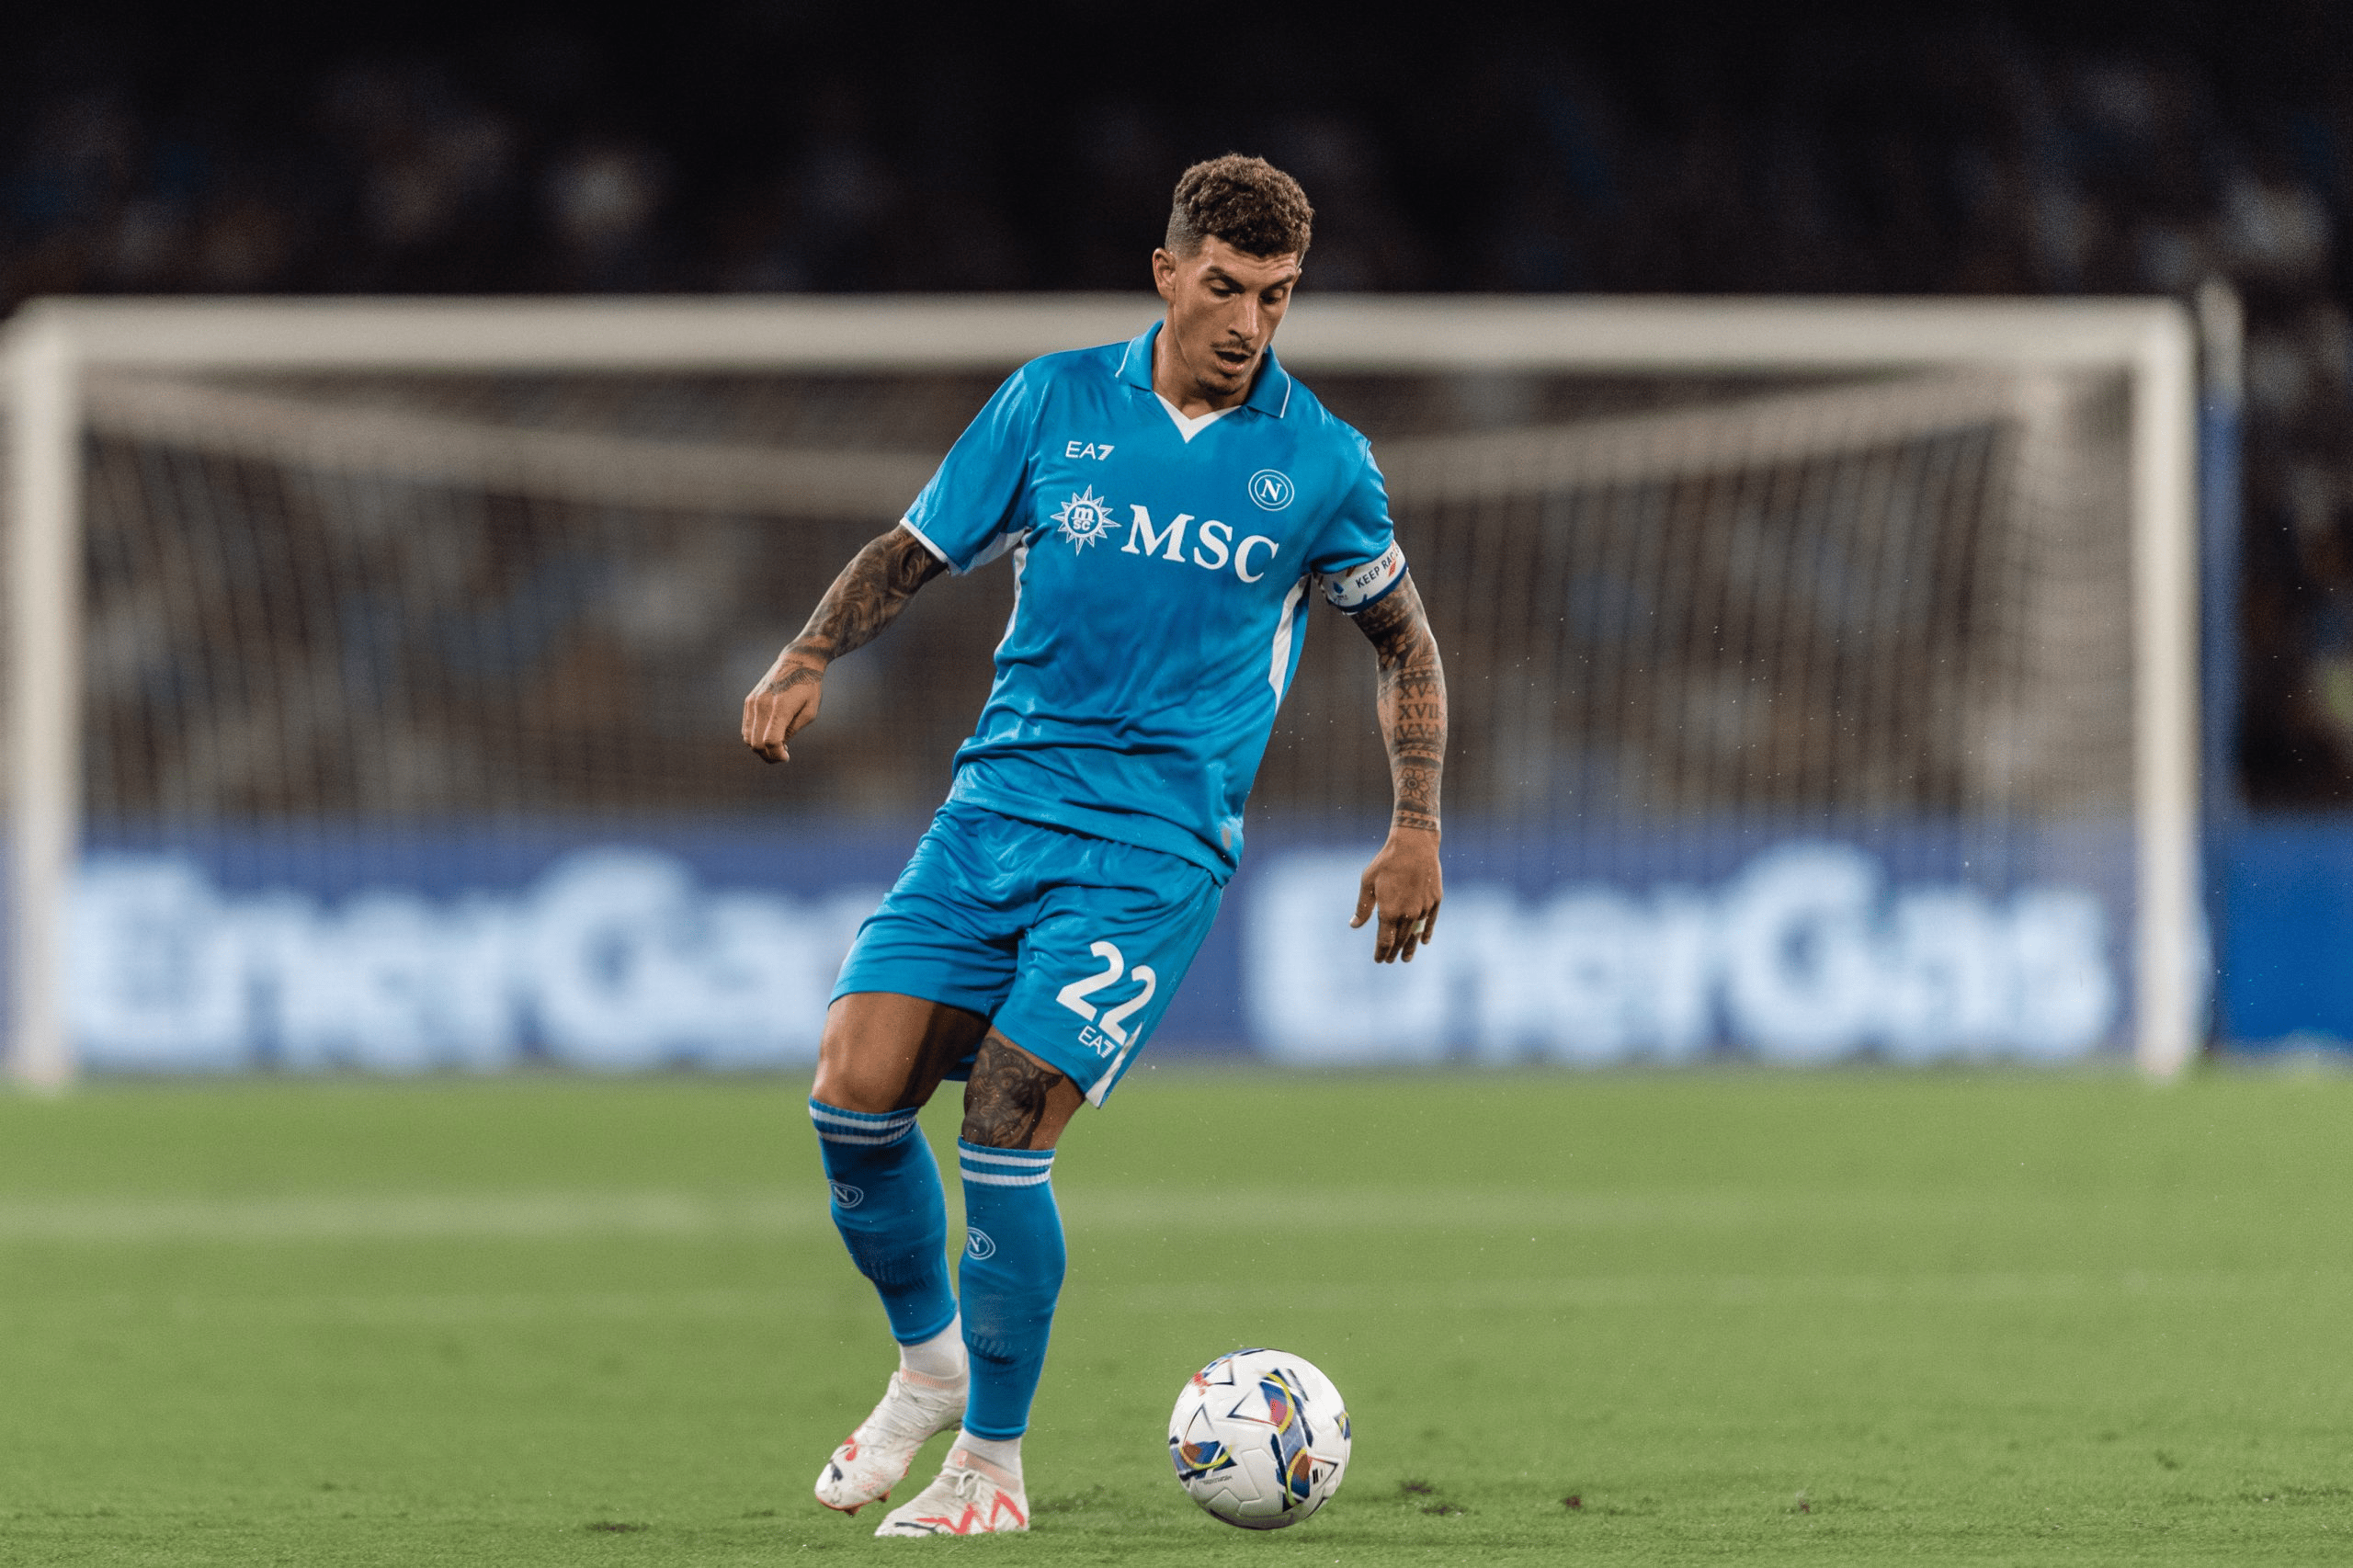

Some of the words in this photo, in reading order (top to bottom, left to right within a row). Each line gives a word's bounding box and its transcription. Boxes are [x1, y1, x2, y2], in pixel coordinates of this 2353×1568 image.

[1065, 440, 1115, 460] EA7
[1260, 478, 1282, 502] N
[1120, 504, 1279, 584] MSC
[1356, 565, 1381, 588] KEEP
[1056, 941, 1156, 1046] 22
[1077, 1025, 1117, 1059] EA7
